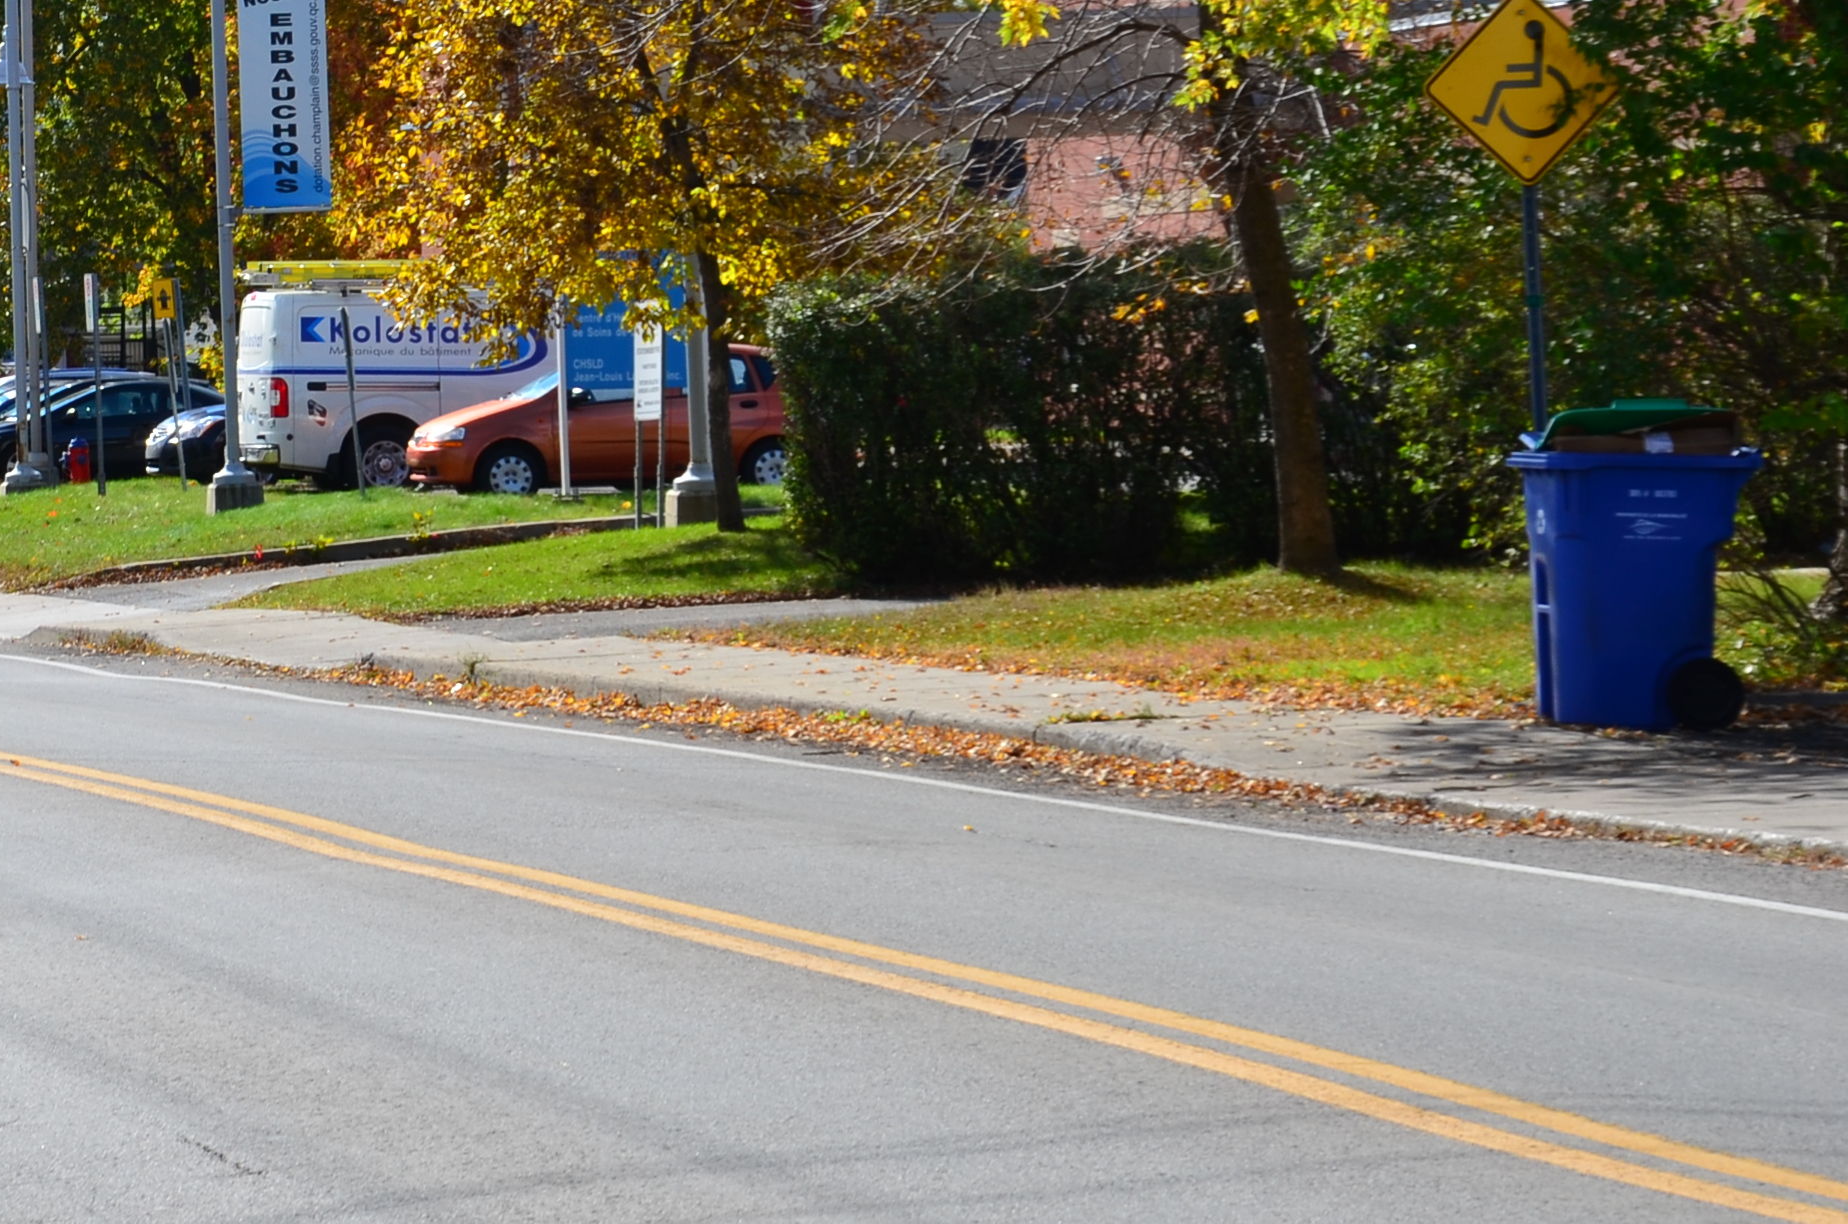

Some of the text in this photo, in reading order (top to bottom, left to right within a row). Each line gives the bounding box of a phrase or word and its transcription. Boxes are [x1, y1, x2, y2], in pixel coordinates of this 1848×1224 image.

[270, 12, 299, 194] EMBAUCHONS
[330, 315, 474, 344] Kolostat
[400, 346, 414, 356] du
[420, 345, 472, 357] bâtiment
[573, 358, 604, 370] CHSLD
[573, 371, 623, 382] Jean-Louis
